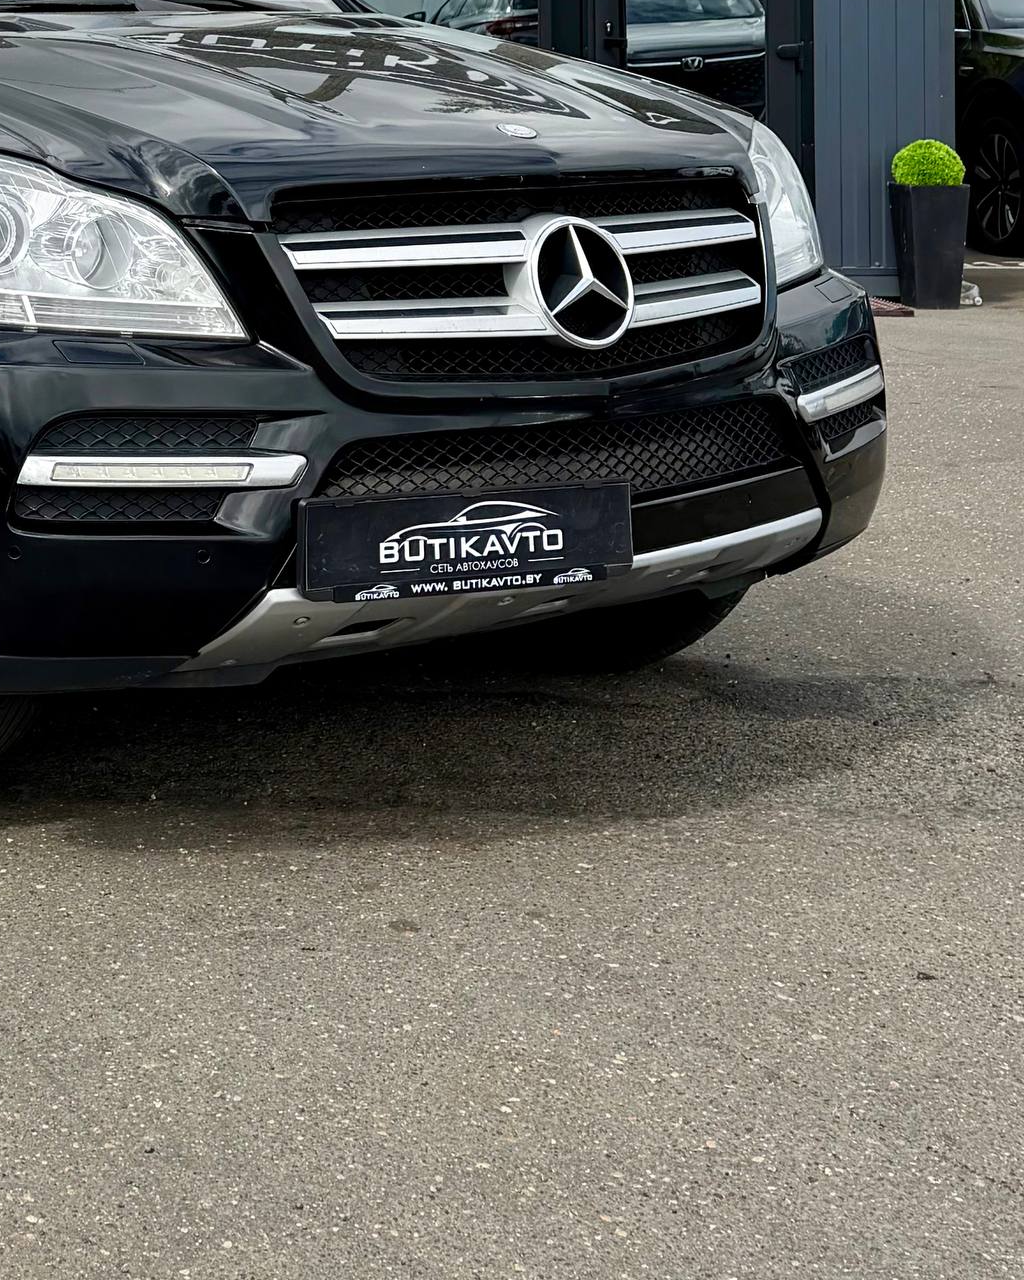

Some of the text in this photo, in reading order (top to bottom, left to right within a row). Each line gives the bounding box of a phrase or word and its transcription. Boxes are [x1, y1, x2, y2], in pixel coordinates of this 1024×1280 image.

[379, 529, 563, 563] BUTIKAVTO
[430, 558, 519, 574] СЕТЬ АВТОХАУСОВ
[411, 573, 543, 594] WWW. BUTIKAVTO.BY
[553, 574, 593, 584] BUTIKAVTO
[355, 591, 400, 600] BUTIKAVTO
